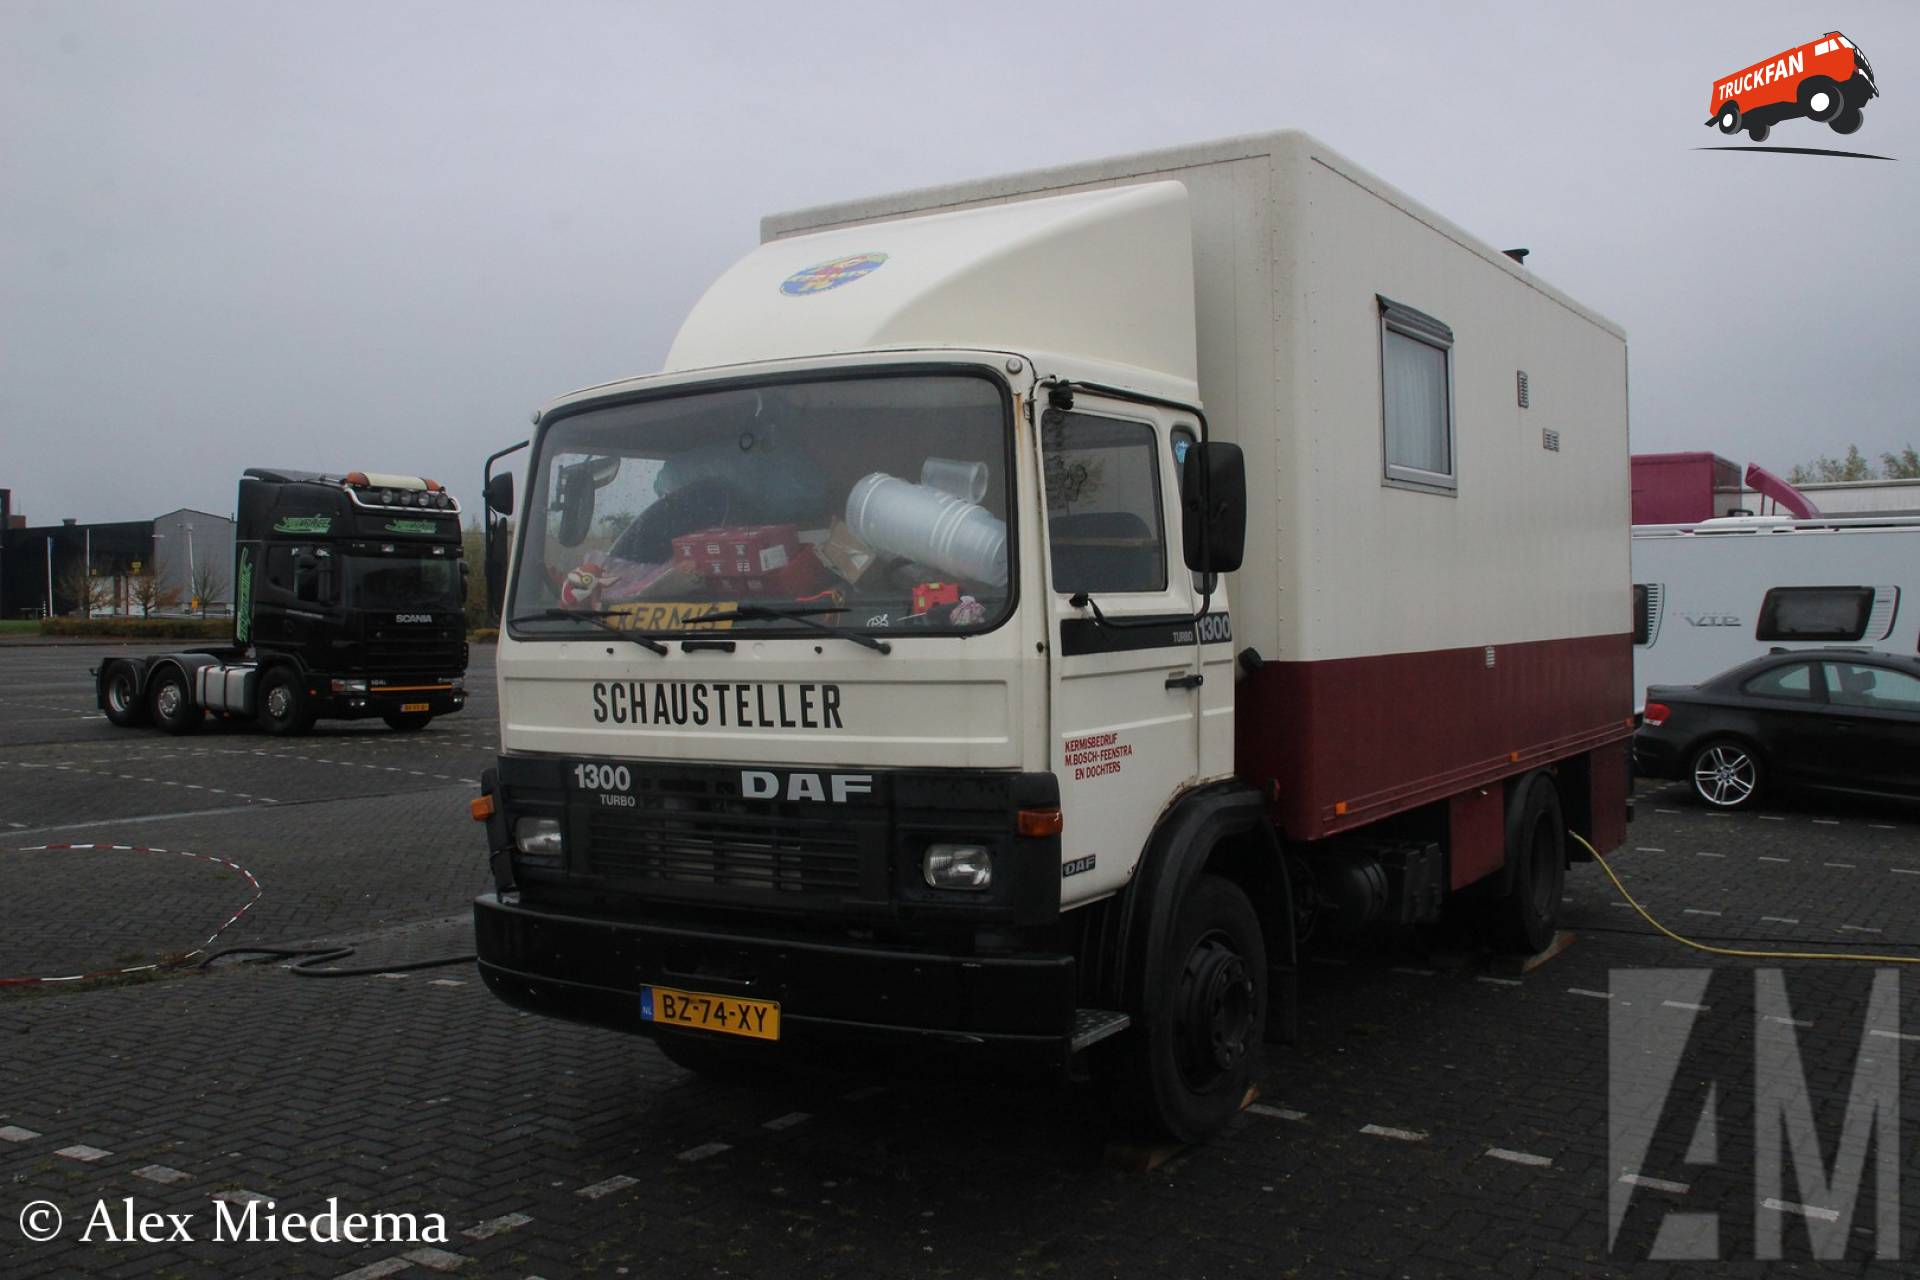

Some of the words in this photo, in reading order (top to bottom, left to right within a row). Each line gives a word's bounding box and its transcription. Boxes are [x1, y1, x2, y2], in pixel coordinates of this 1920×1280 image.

[395, 614, 433, 623] SCANIA
[1199, 614, 1233, 641] 1300
[1172, 630, 1194, 643] TURBO
[592, 682, 844, 729] SCHAUSTELLER
[573, 763, 631, 791] 1300
[1075, 767, 1085, 781] EN
[1086, 760, 1122, 779] DOCHTERS
[741, 770, 873, 803] DAF
[599, 794, 636, 808] TURBO
[1063, 857, 1096, 876] DAF
[662, 993, 768, 1033] BZ-74-XY
